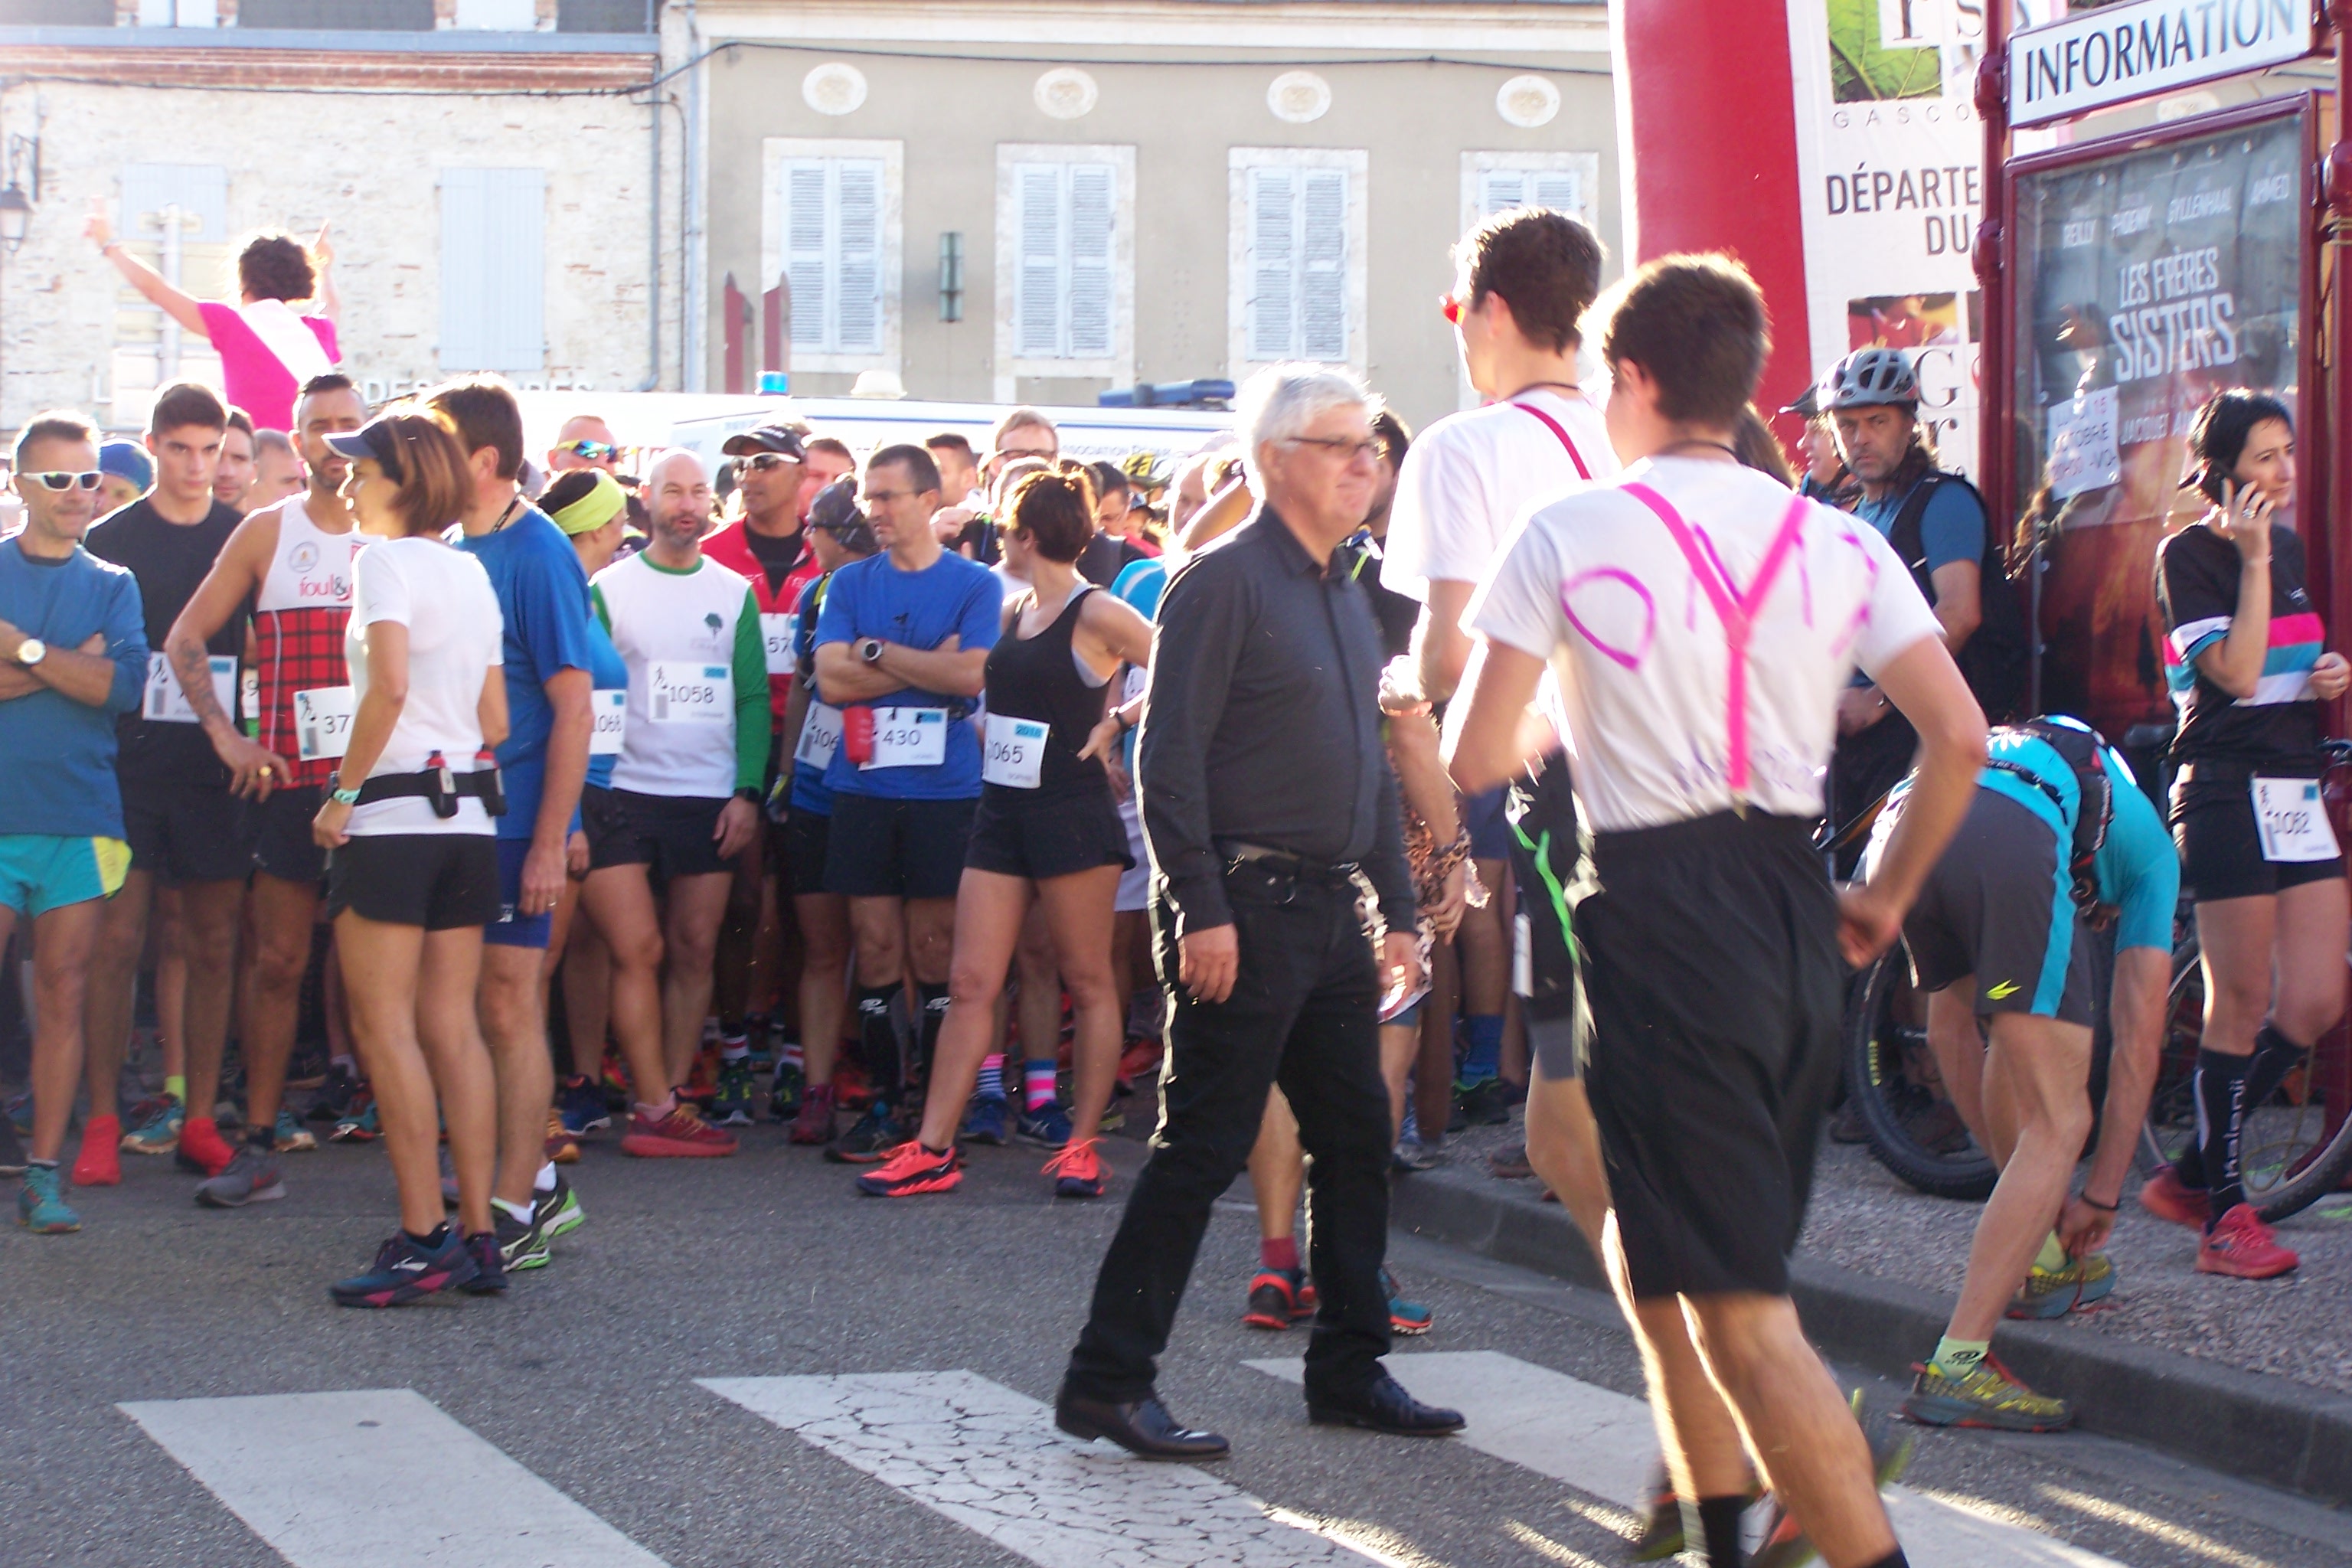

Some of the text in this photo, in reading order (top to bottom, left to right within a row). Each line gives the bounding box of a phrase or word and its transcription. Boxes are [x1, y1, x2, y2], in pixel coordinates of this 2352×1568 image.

[2025, 0, 2295, 104] INFORMATION
[1826, 162, 1980, 215] DÉPARTE
[1926, 214, 1970, 256] DU
[2119, 246, 2220, 309] LES FRÈRES
[2109, 292, 2236, 382] SISTERS
[669, 685, 714, 704] 1058
[883, 729, 922, 746] 430
